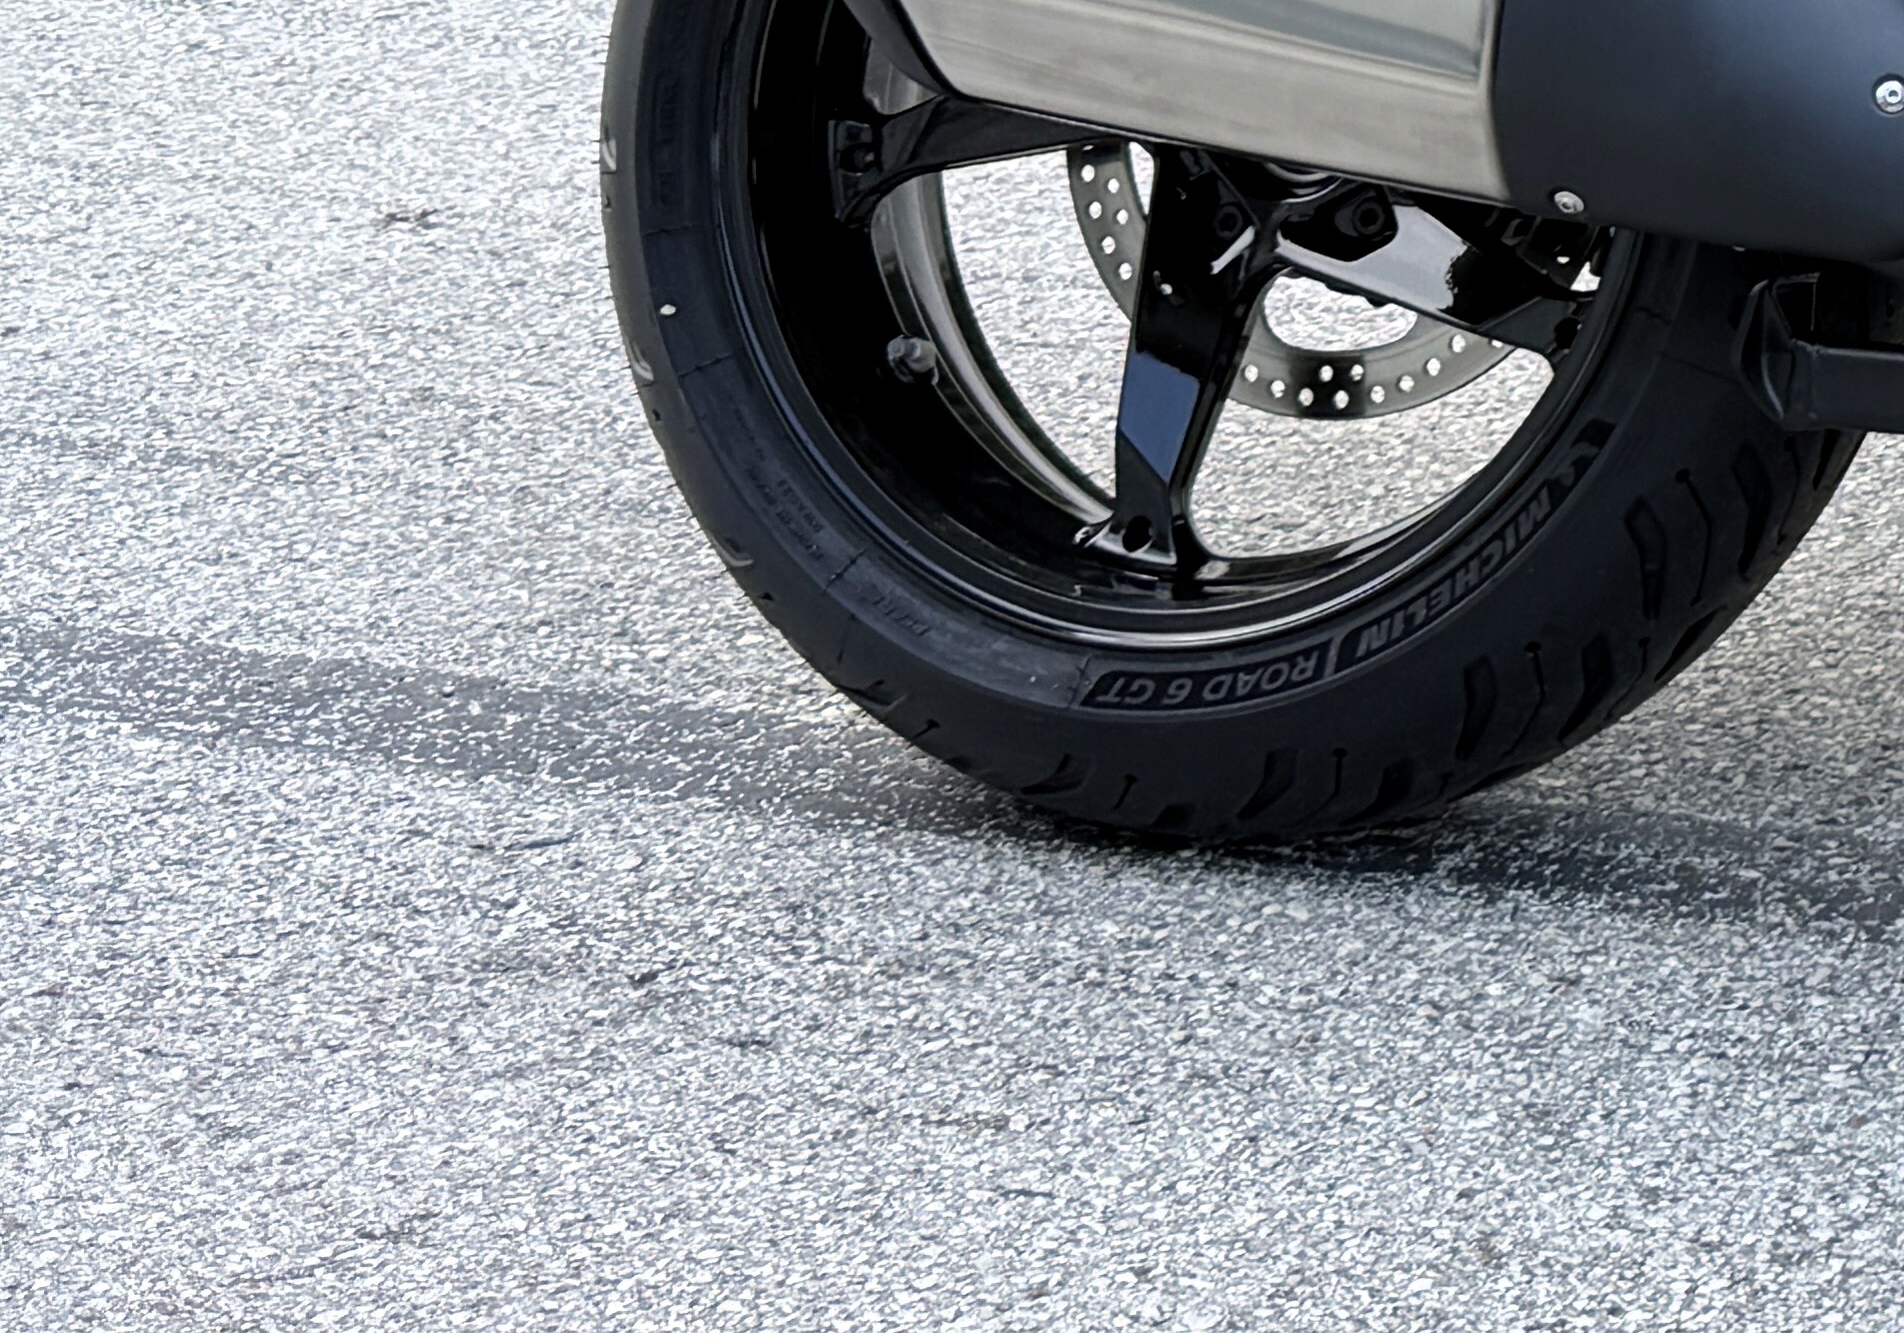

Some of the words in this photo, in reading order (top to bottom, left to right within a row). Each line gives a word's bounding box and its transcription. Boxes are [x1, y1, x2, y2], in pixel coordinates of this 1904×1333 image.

[1356, 485, 1554, 656] MICHELIN
[1095, 675, 1155, 704] GT
[1161, 675, 1193, 704] 6
[1202, 644, 1319, 703] ROAD
